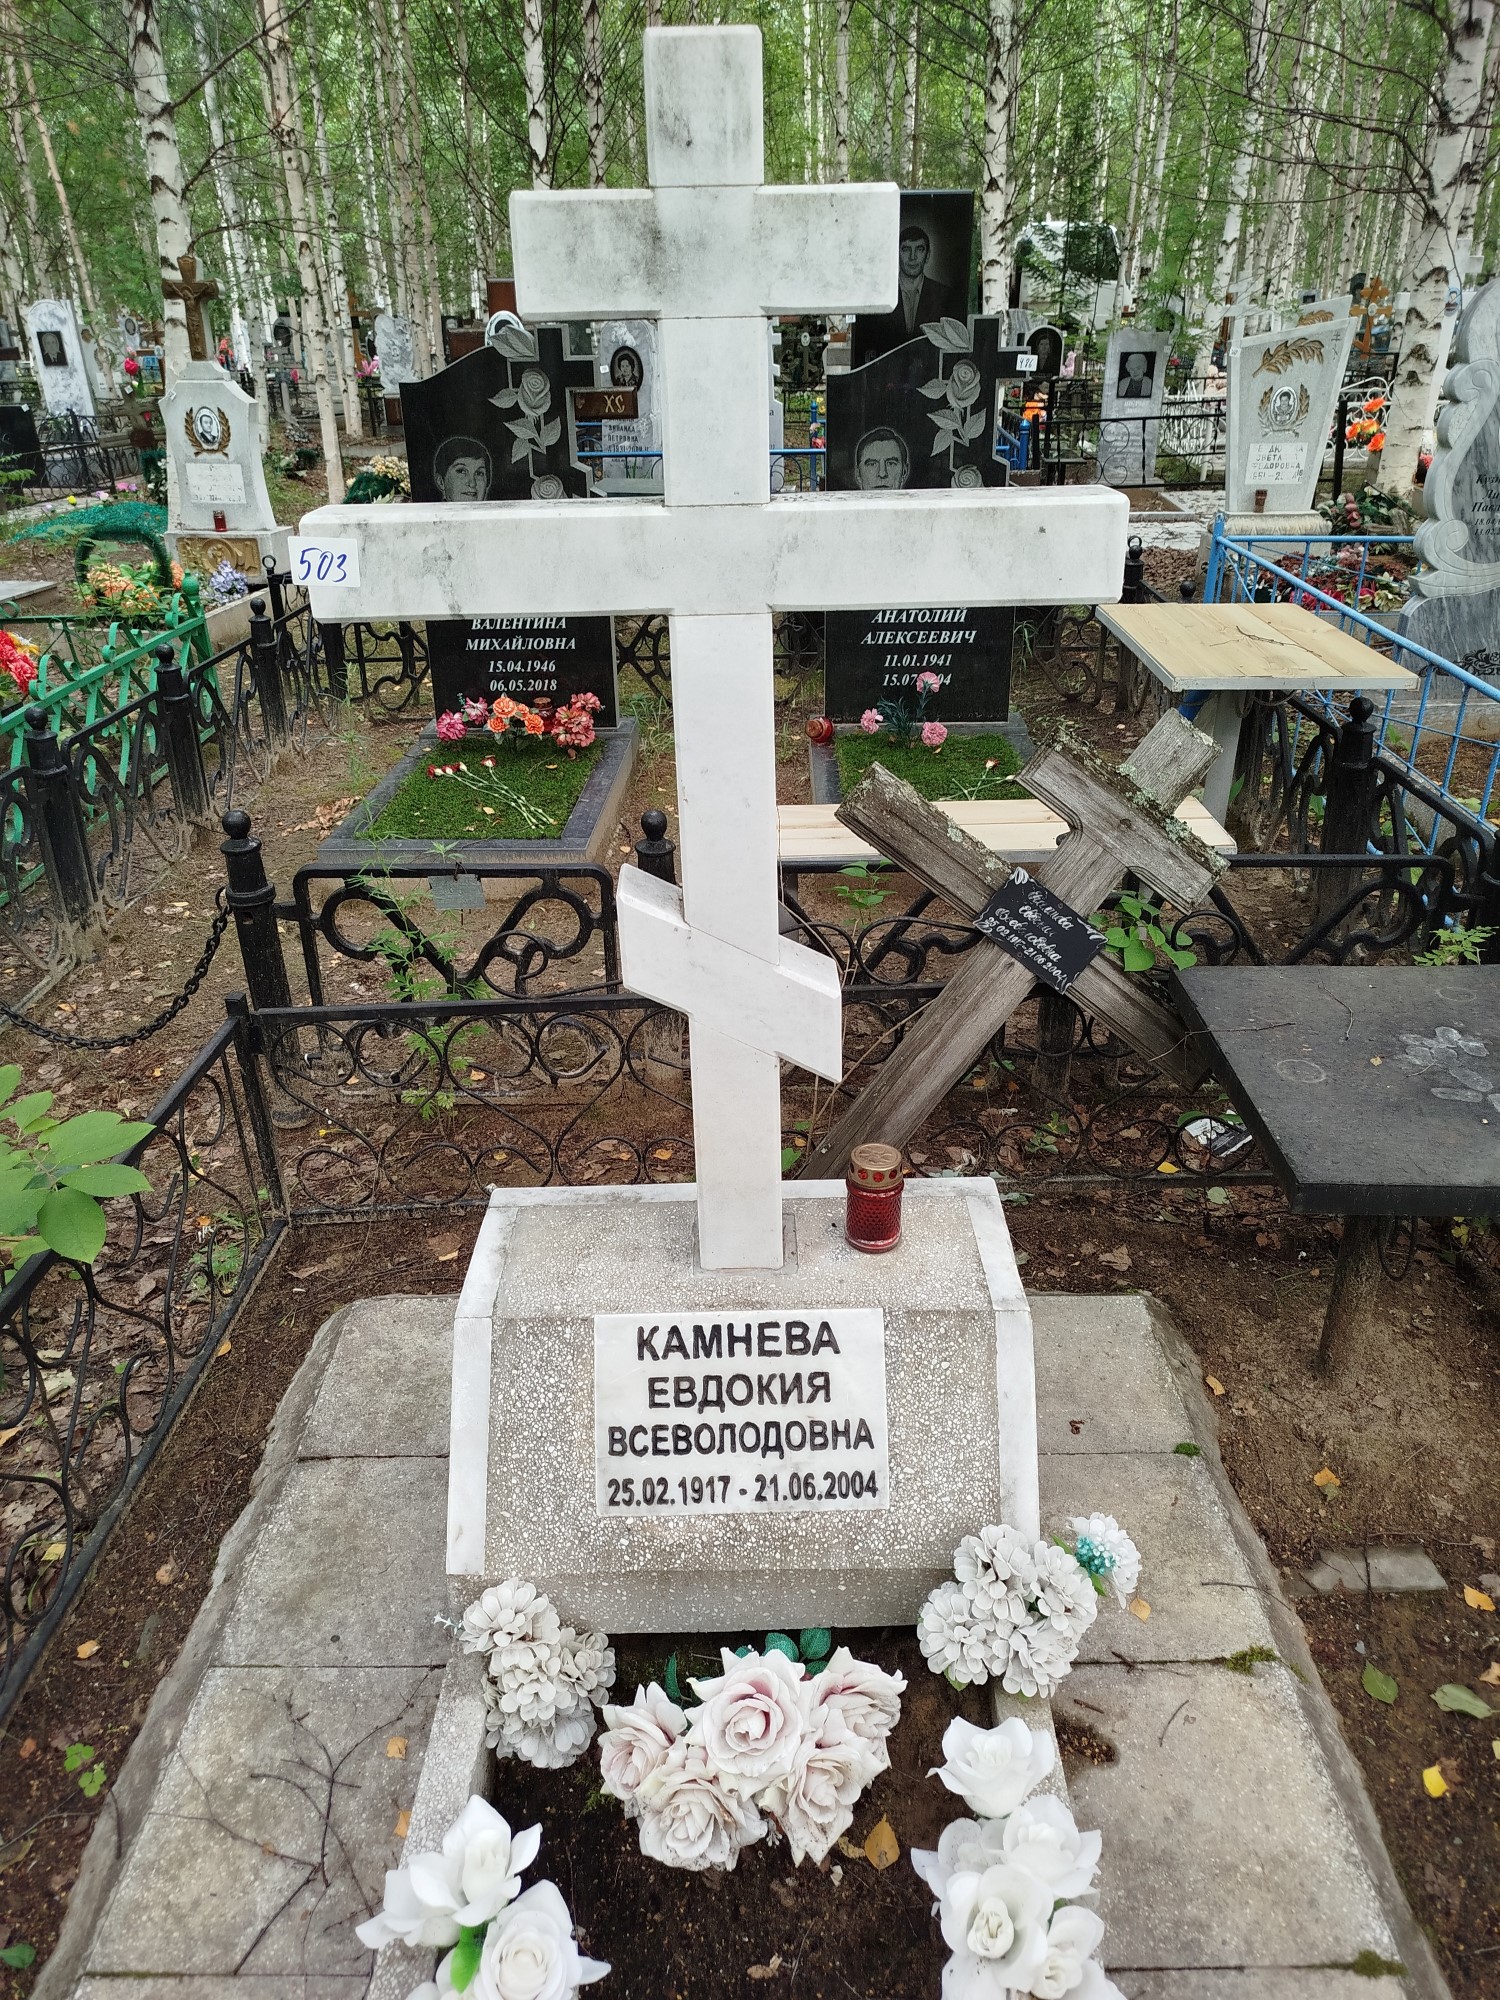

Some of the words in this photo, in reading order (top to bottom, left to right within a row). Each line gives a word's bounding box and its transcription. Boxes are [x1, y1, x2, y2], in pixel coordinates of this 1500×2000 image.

[1251, 462, 1301, 470] ФЕДОРОВА
[298, 547, 347, 583] 503
[871, 606, 968, 623] АНАТОЛИЙ
[471, 617, 567, 630] ВАЛЕНТИНА
[465, 635, 576, 651] МИХАЙЛОВНА
[860, 630, 977, 644] АЛЕКСЕЕВИЧ
[488, 660, 556, 673] 15.04.1946
[883, 654, 952, 667] 11.01.1941
[489, 679, 558, 691] 06.05.2018
[882, 673, 952, 686] 15.074
[636, 1321, 841, 1361] КАМНЕВА
[648, 1371, 832, 1414] ЕВДОКИЯ
[607, 1418, 875, 1460] ВСЕВОЛОДОВНА
[607, 1475, 731, 1506] 25.02.1917
[754, 1470, 879, 1502] 21.06.2004
